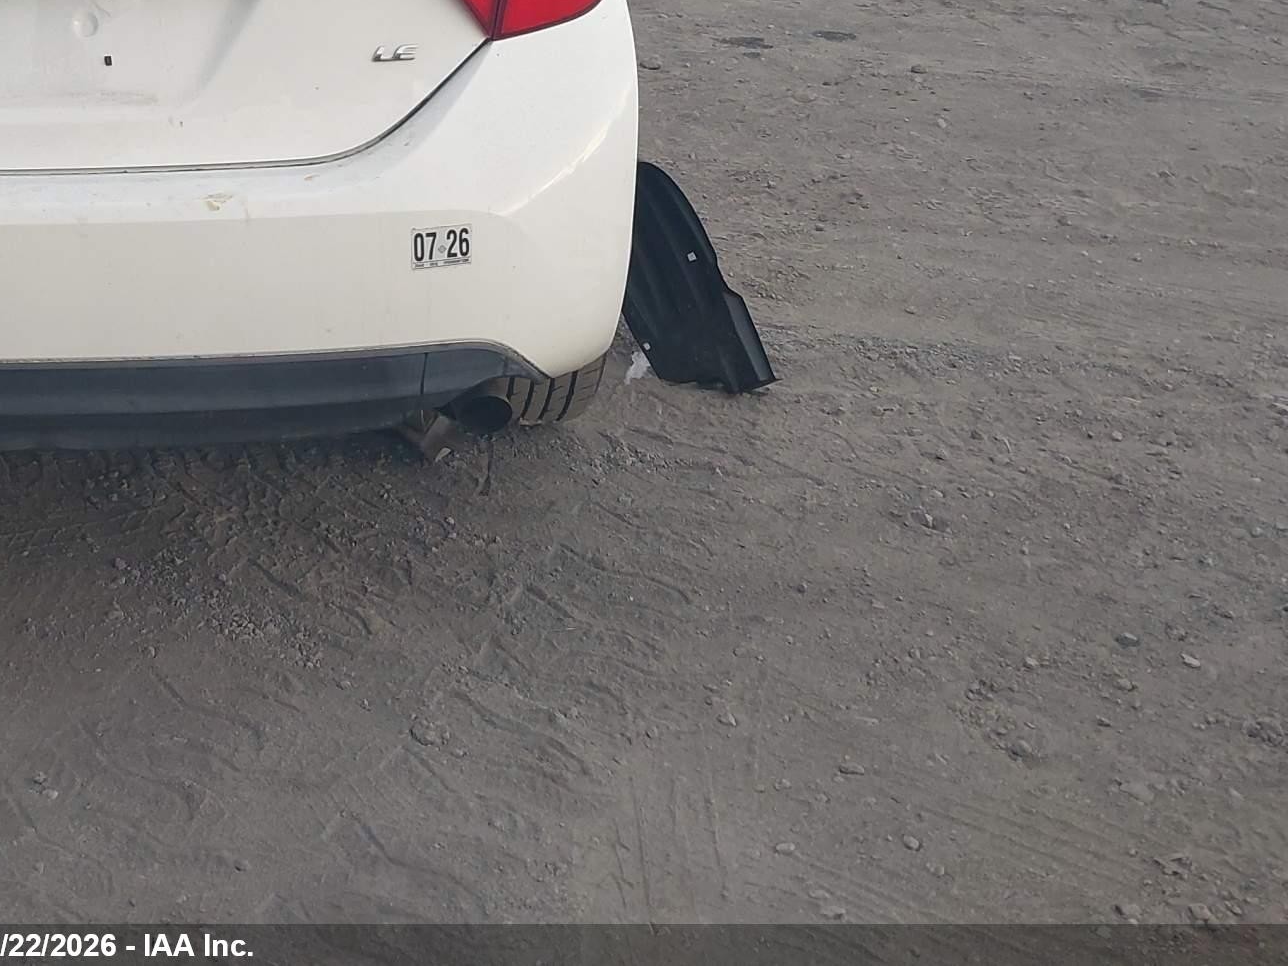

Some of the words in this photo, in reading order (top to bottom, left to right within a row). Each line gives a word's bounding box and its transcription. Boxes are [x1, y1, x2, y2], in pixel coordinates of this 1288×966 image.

[372, 44, 418, 62] LE
[413, 232, 437, 262] 07
[446, 227, 470, 258] 26
